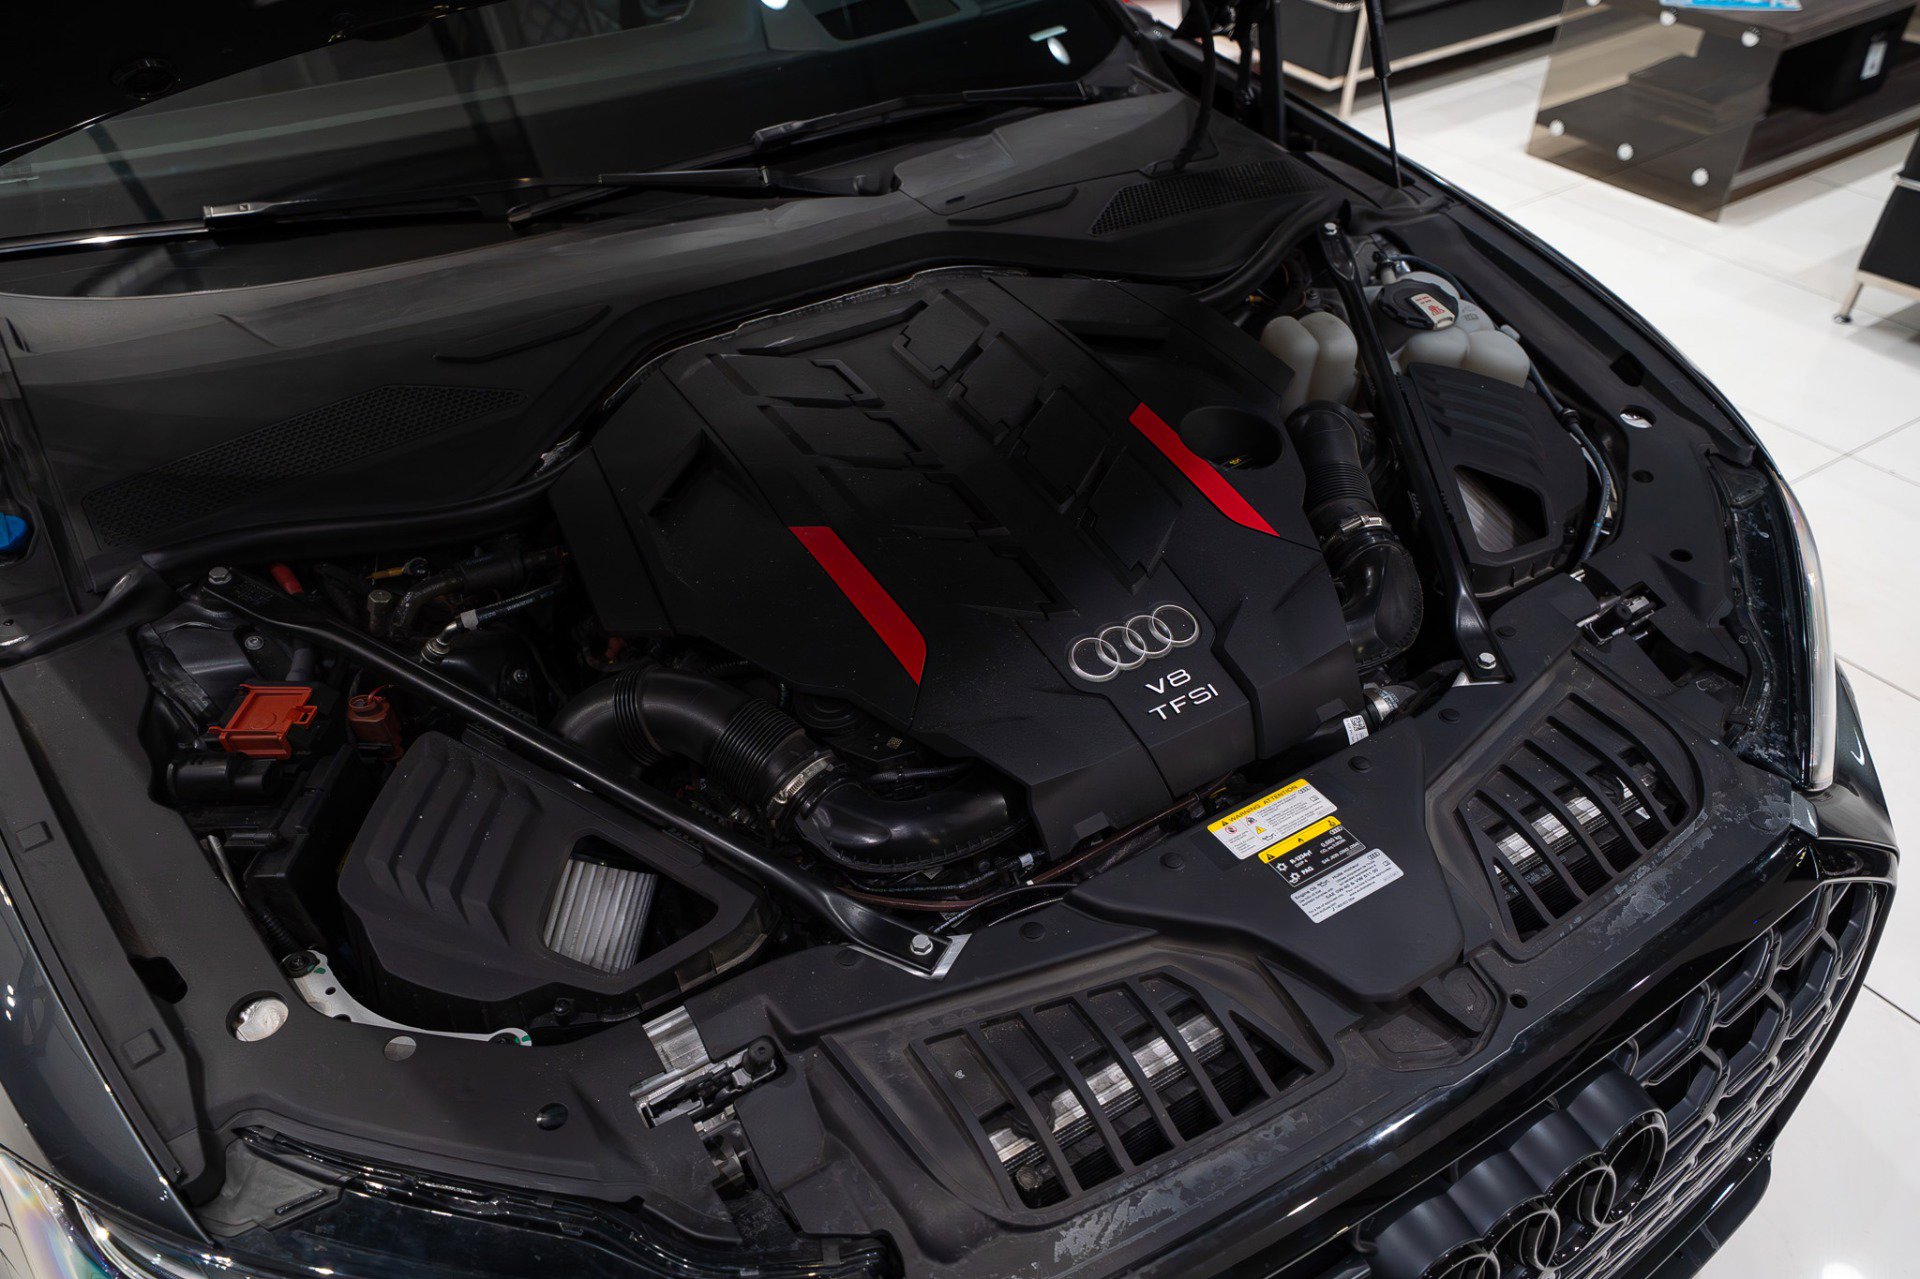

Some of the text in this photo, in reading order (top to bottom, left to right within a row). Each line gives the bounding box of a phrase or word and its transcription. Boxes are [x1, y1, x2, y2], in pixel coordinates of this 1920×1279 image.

[1145, 669, 1191, 694] V8
[1148, 684, 1218, 720] TFSI
[1229, 804, 1261, 822] WARNING
[1263, 785, 1298, 805] ATTENTION
[1301, 866, 1314, 875] PAG
[1295, 890, 1311, 901] Engine
